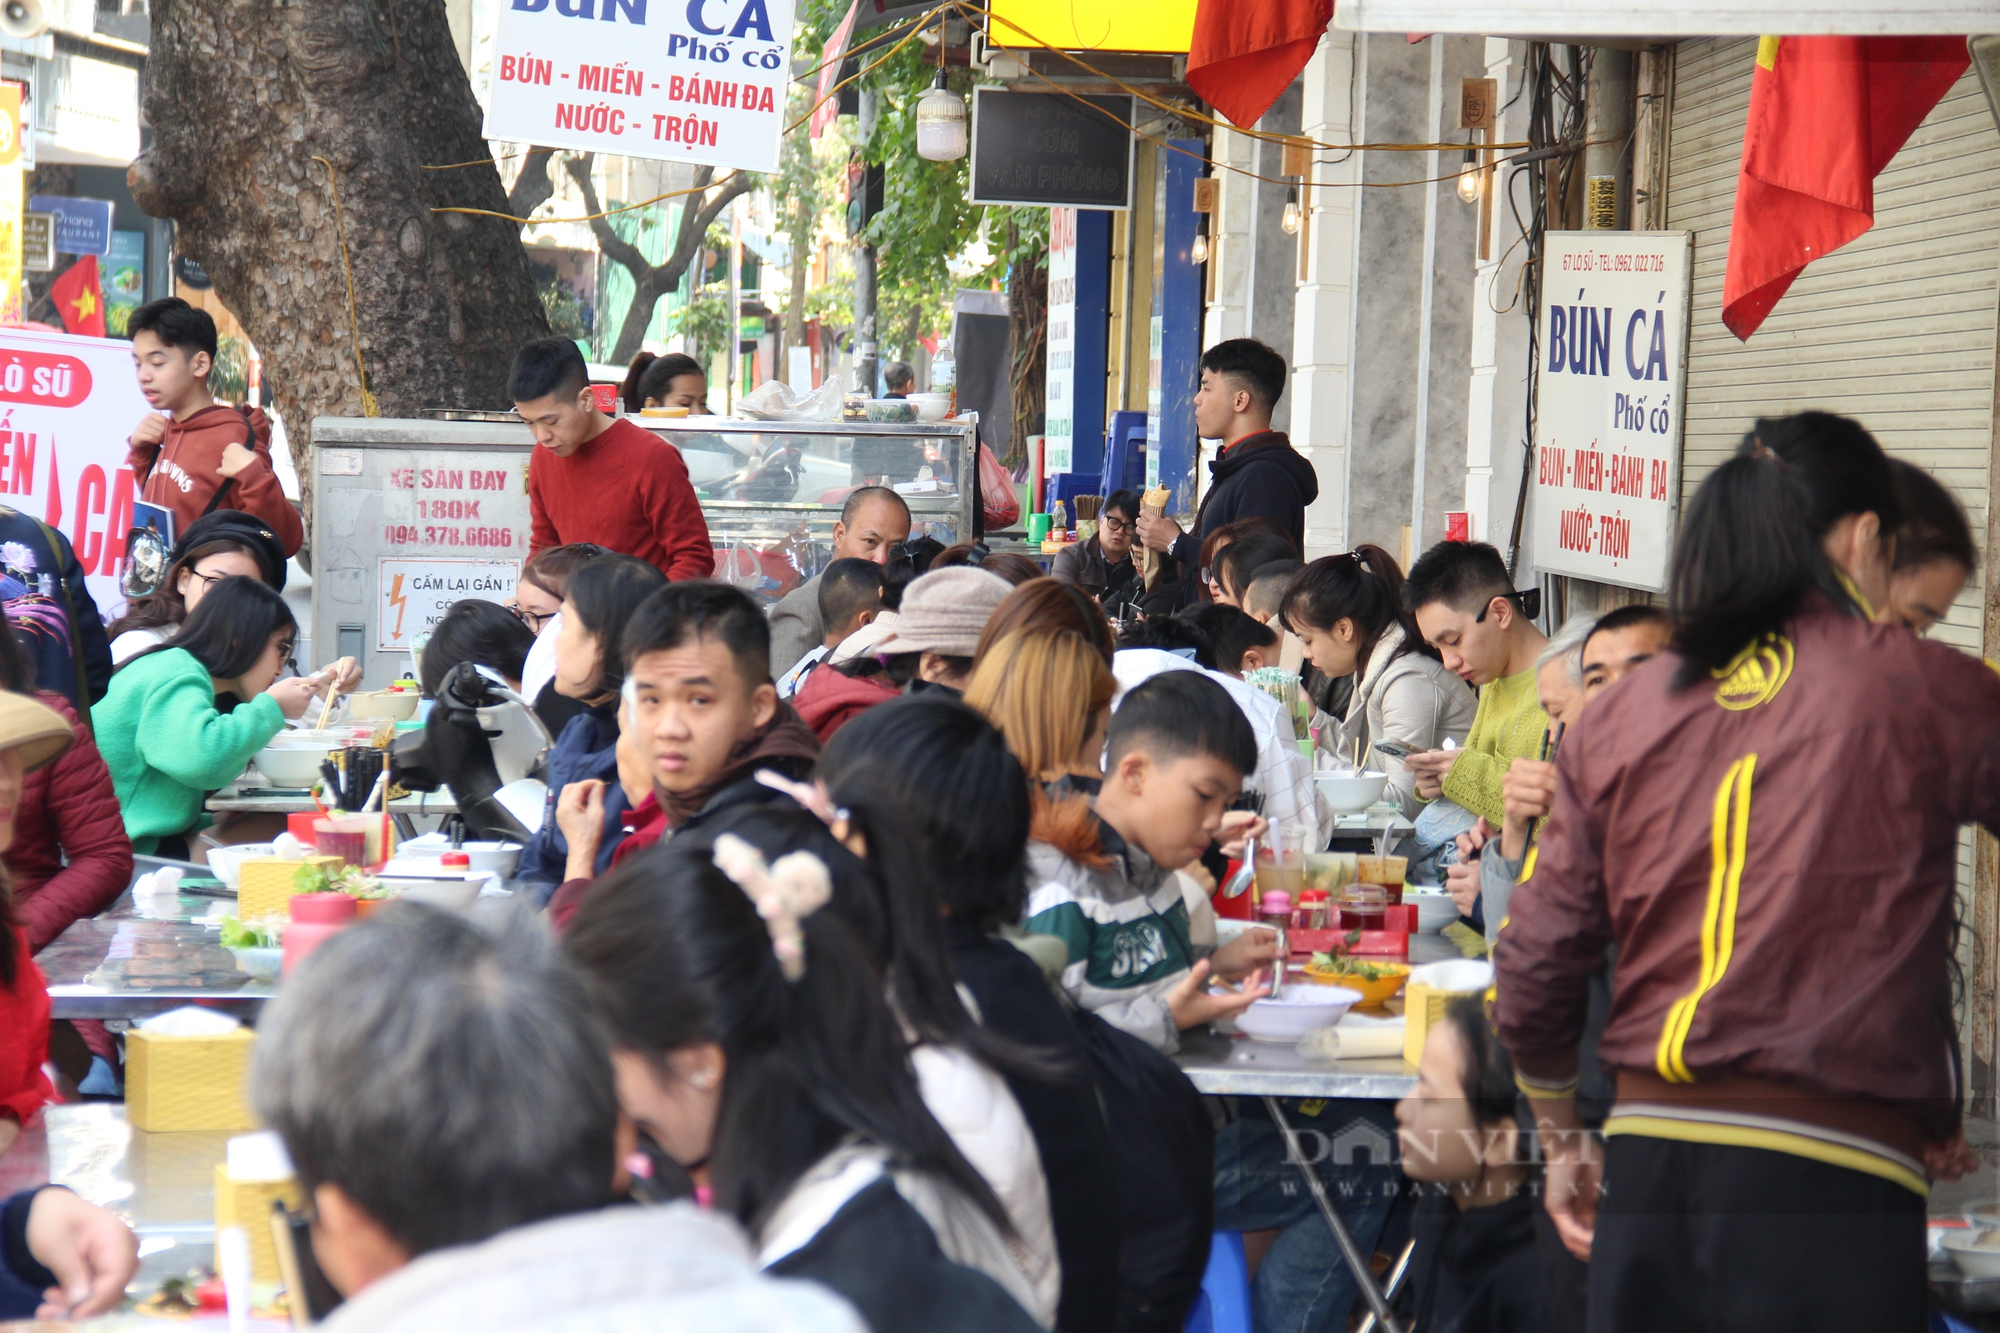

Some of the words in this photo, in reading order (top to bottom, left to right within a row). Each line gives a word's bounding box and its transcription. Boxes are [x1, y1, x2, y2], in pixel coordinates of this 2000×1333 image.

[667, 33, 734, 63] Phố
[742, 45, 784, 70] cổ
[500, 51, 552, 86] BÚN
[577, 61, 644, 97] MIẾN
[668, 72, 739, 108] BÁNH
[742, 84, 775, 113] ĐA
[555, 101, 625, 135] NƯỚC
[652, 113, 719, 150] TRỘN
[1563, 254, 1572, 271] 67
[1573, 251, 1582, 271] LÒ
[1583, 249, 1593, 271] SŨ
[1599, 254, 1613, 271] TEL:
[1614, 254, 1632, 272] 0962
[1634, 254, 1648, 272] 022
[1650, 254, 1664, 272] 716
[1548, 288, 1613, 377] BÚN
[1625, 290, 1669, 382] CÁ
[32, 363, 71, 398] SŨ
[1614, 392, 1647, 431] Phố
[1650, 393, 1671, 435] cổ
[390, 468, 414, 489] XE
[421, 465, 463, 490] SÂN
[470, 470, 507, 491] BAY
[1539, 438, 1566, 487] BÚN
[1573, 438, 1604, 492] MIẾN
[1611, 445, 1645, 499] BÁNH
[1650, 458, 1667, 501] ĐA
[416, 499, 481, 520] 180K
[1560, 503, 1593, 553] NƯỚC
[1599, 509, 1631, 567] TRỘN
[413, 573, 443, 591] CẤM
[447, 577, 469, 594] LẠI
[473, 574, 502, 591] GẦN
